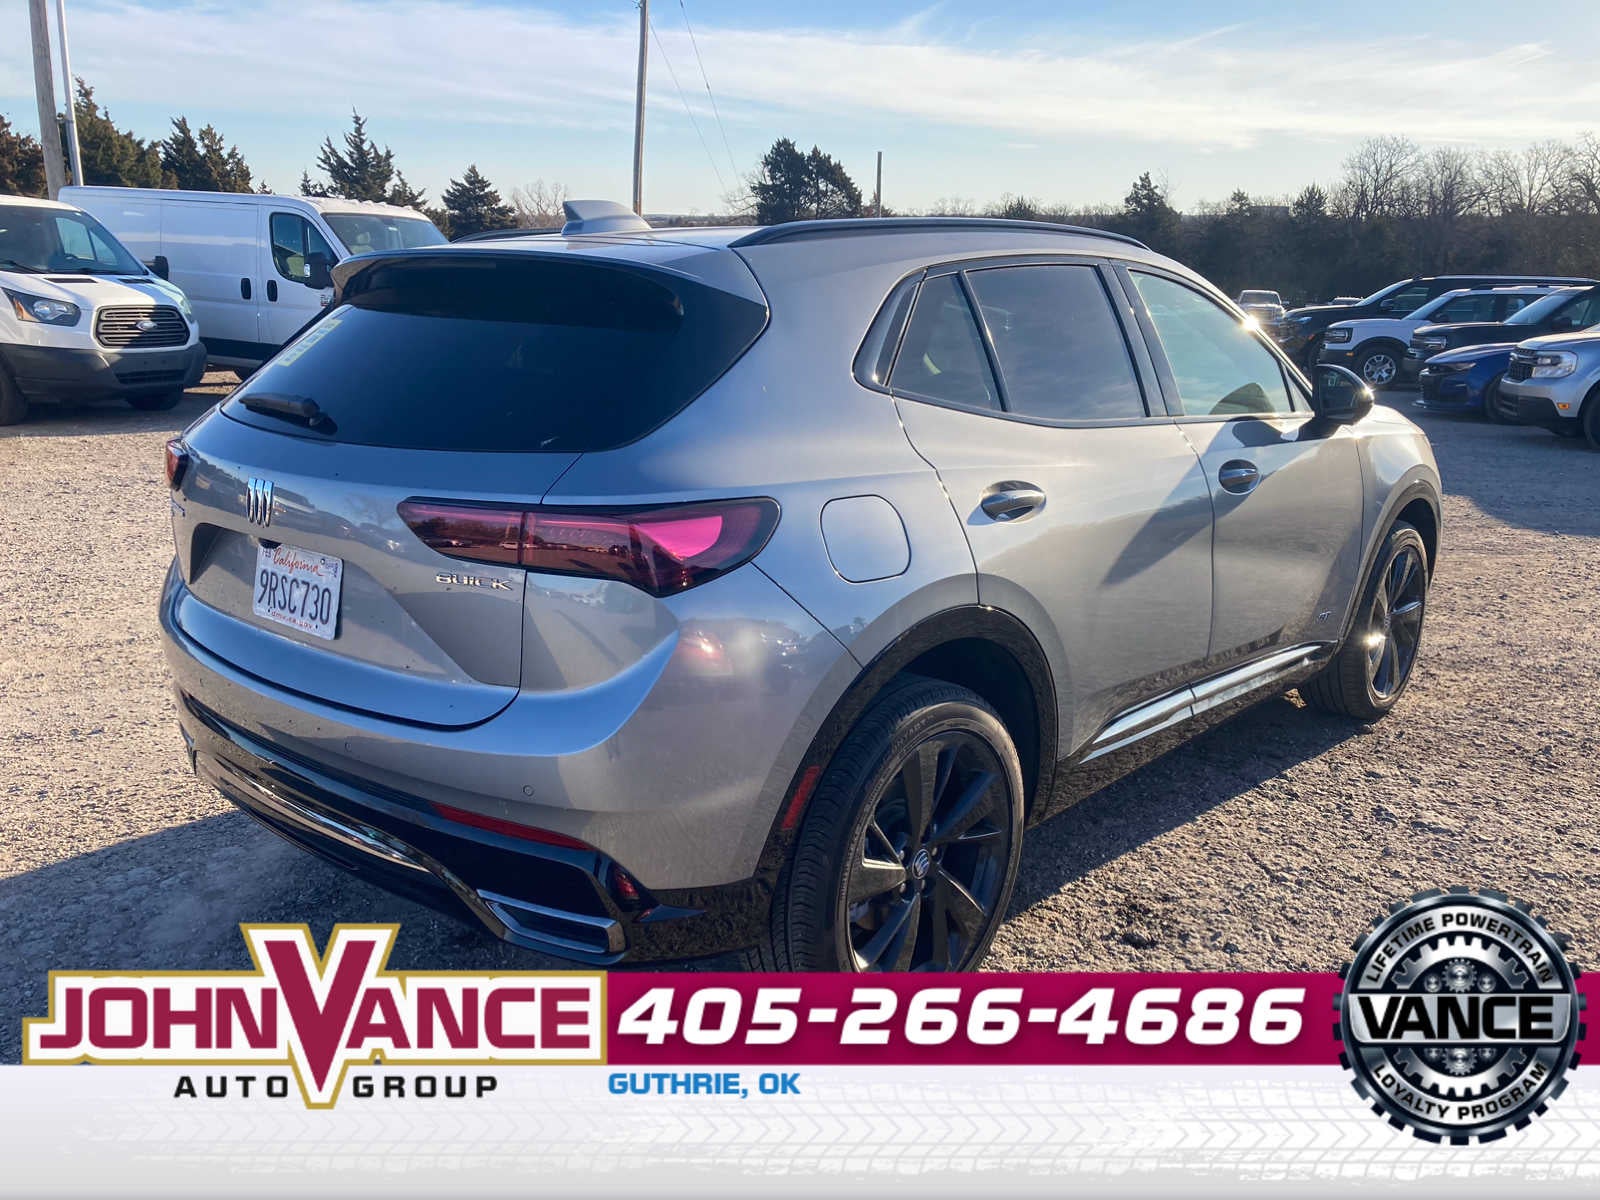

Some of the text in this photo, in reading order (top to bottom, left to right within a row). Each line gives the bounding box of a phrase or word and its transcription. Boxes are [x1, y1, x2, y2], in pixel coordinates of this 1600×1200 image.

[273, 547, 324, 576] California
[257, 569, 332, 625] 9RSC730
[435, 574, 513, 591] BUICK
